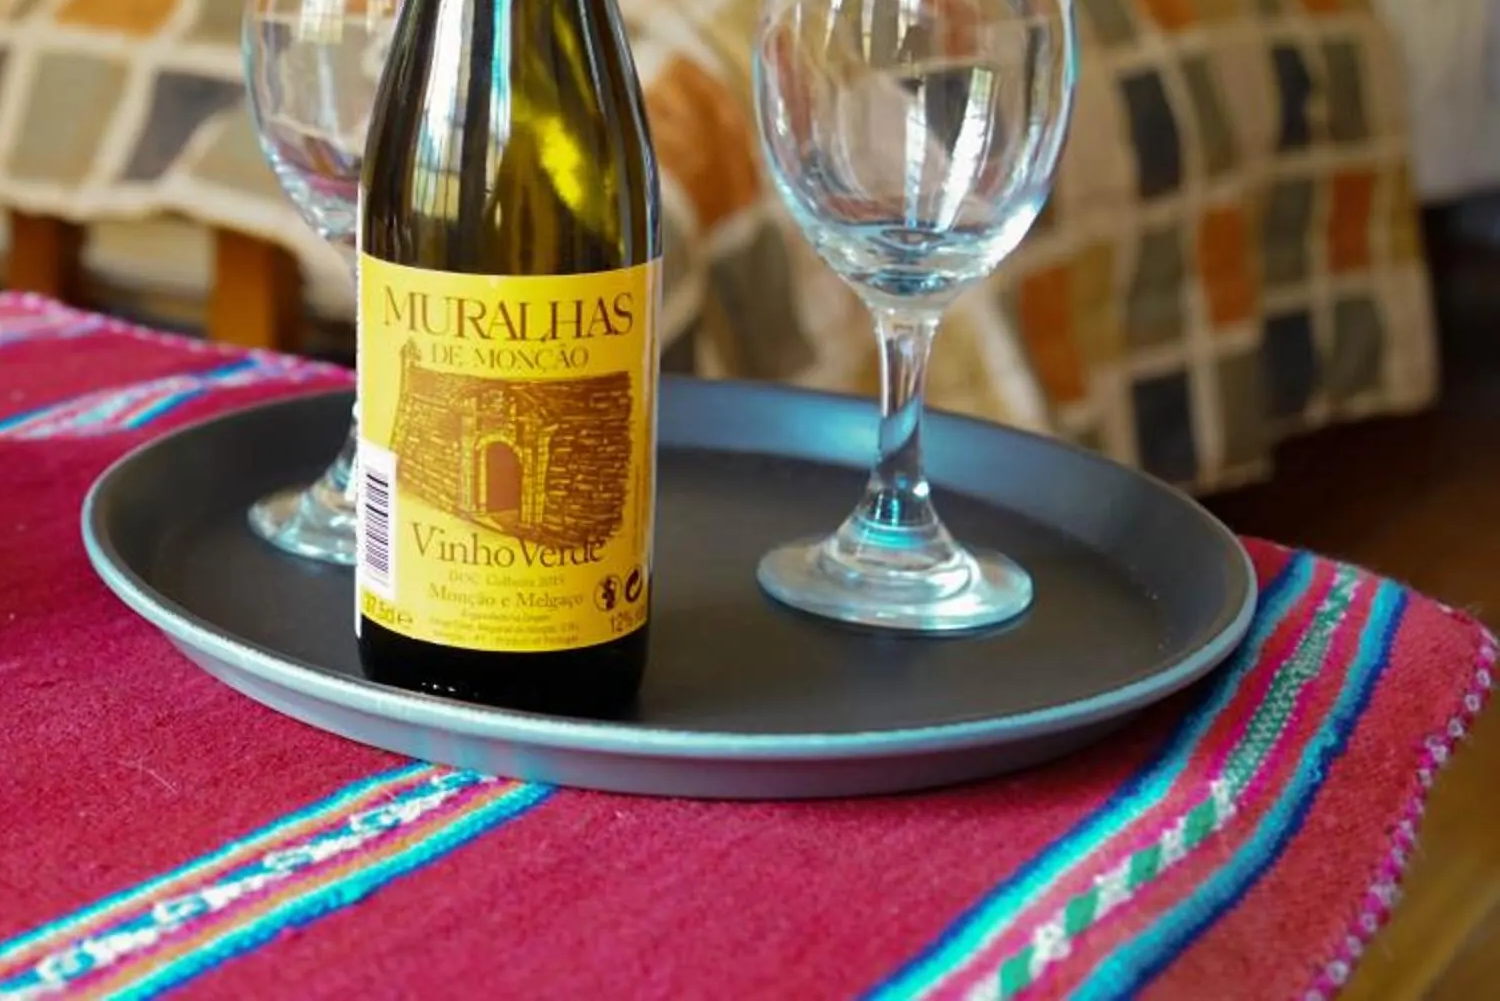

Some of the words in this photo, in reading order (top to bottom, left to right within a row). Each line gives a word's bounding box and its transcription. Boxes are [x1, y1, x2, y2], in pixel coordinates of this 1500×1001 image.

[383, 285, 634, 342] MURALHAS
[431, 346, 463, 366] DE
[474, 343, 590, 371] MONÇÃO
[409, 522, 516, 568] Vinho
[517, 537, 607, 568] Verde
